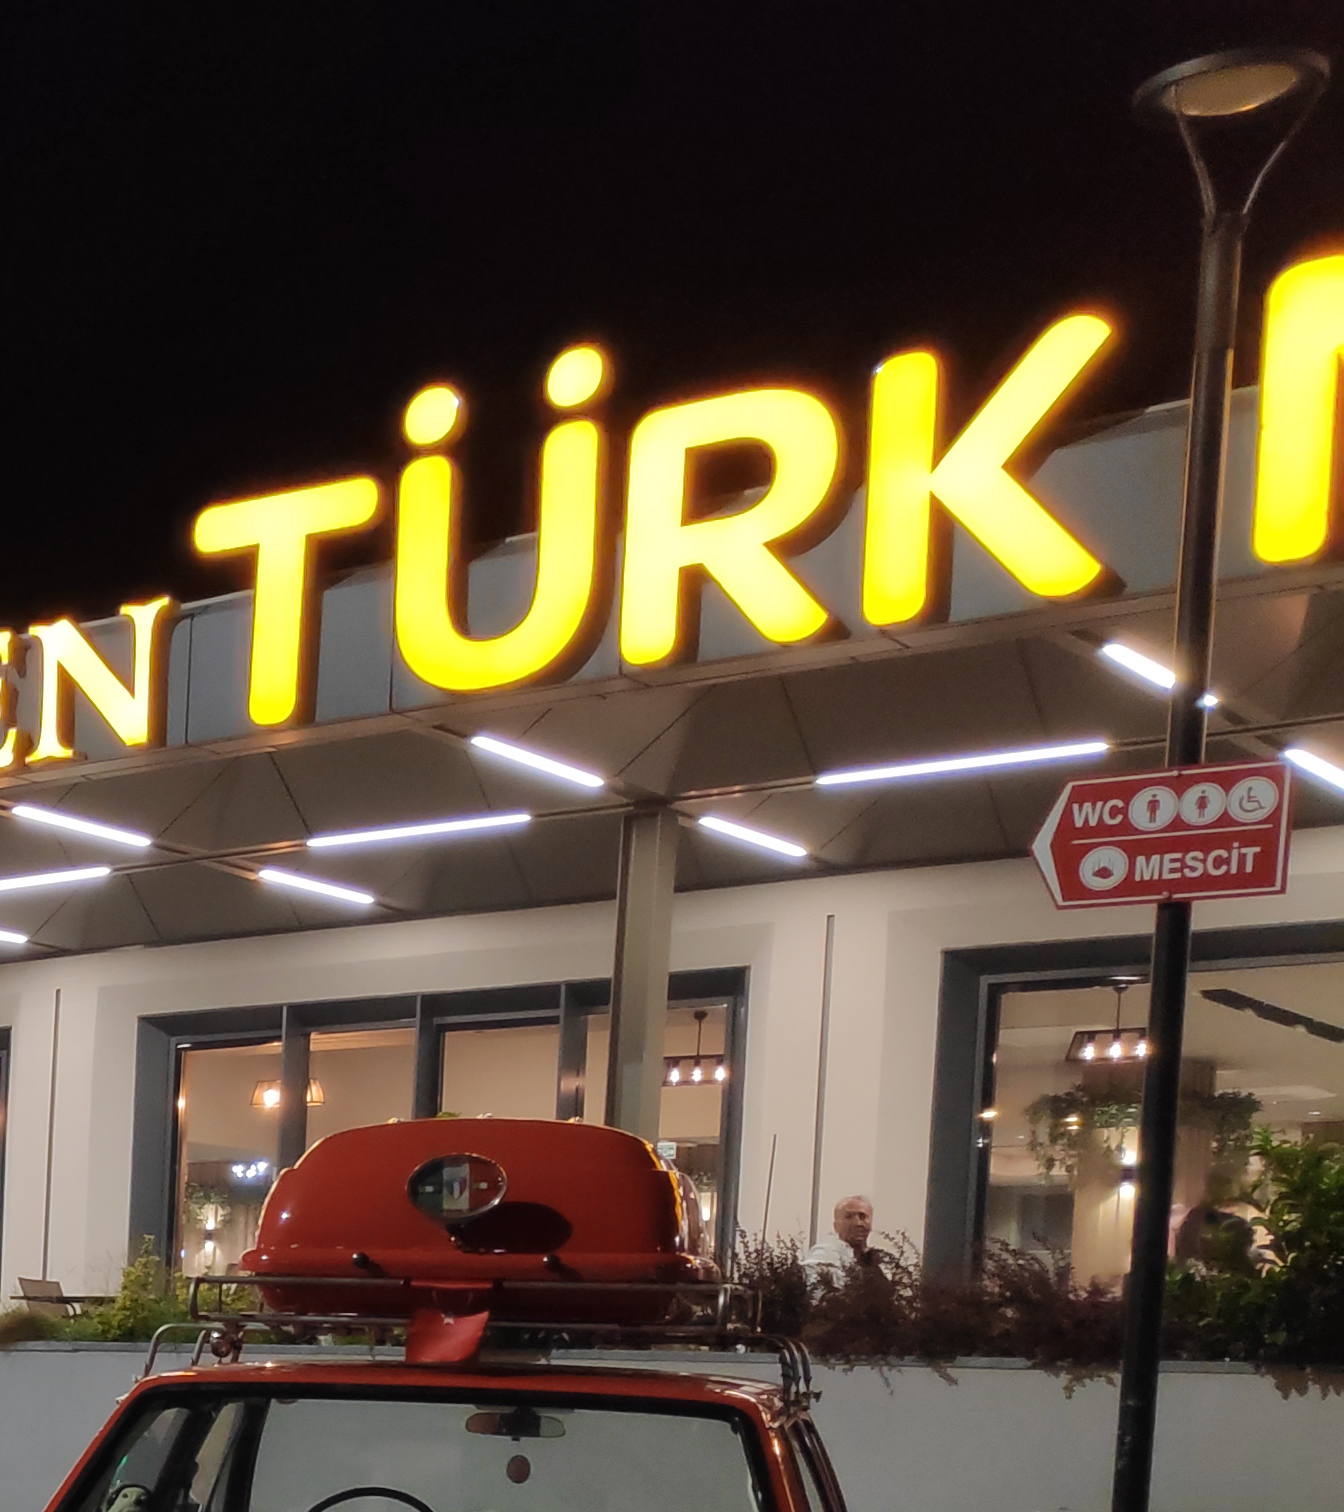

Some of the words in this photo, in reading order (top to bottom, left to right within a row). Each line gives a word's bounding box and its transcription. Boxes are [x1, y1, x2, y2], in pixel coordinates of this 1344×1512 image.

[192, 313, 1112, 725] TÜRK
[1071, 799, 1126, 828] WC
[1134, 842, 1262, 882] MESCİT
